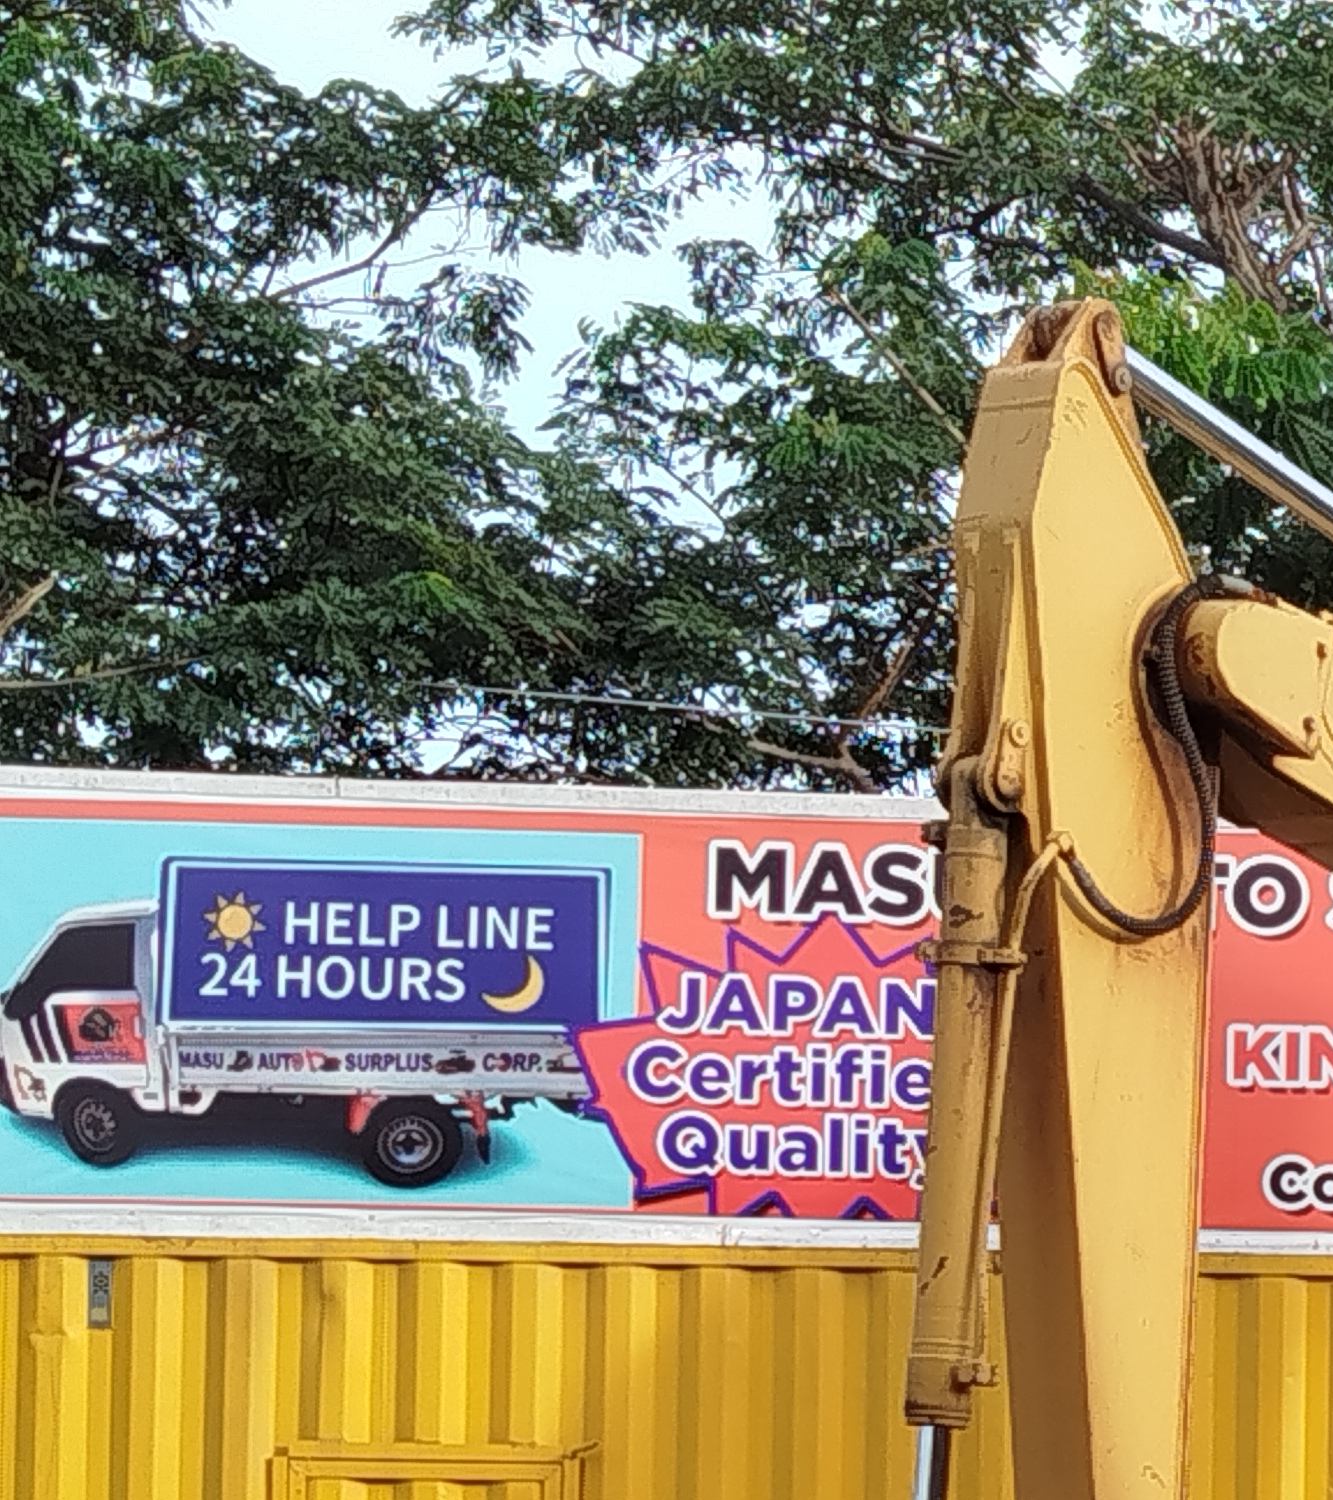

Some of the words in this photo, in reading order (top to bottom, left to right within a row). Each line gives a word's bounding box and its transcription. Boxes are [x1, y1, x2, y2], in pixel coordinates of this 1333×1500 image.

[701, 841, 942, 923] MAS
[284, 901, 421, 947] HELP
[436, 904, 555, 951] LINE
[198, 954, 263, 998] 24
[276, 955, 466, 1002] HOURS
[658, 974, 936, 1037] JAPAN
[344, 1052, 434, 1073] SURPLUS
[630, 1043, 933, 1108] Certifie
